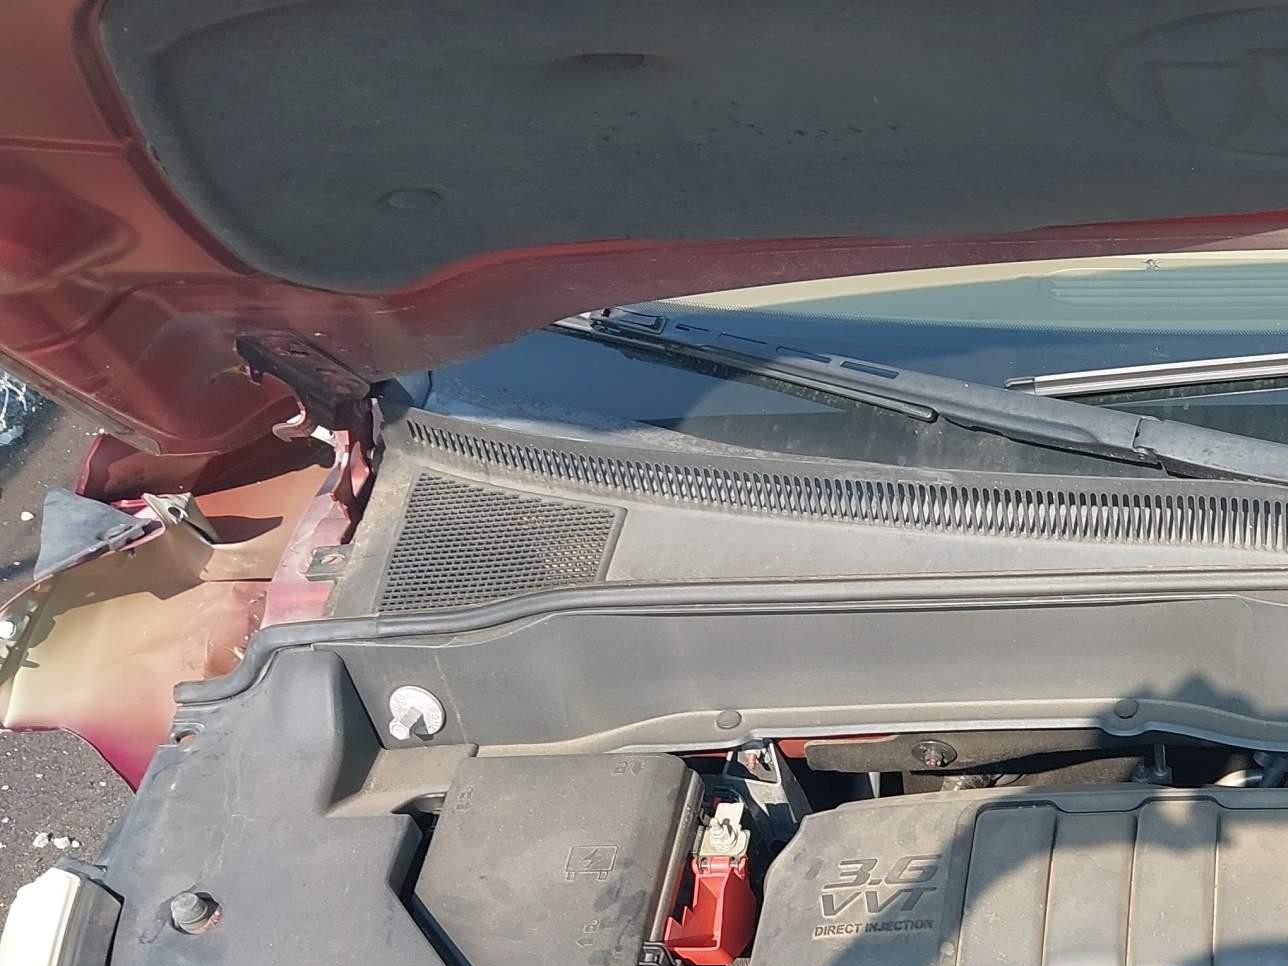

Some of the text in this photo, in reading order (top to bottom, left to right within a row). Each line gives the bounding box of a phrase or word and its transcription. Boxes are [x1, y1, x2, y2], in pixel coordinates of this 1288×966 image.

[823, 854, 942, 890] 3.6
[821, 886, 937, 918] VVT
[815, 919, 933, 937] DIRECT INJECTION
